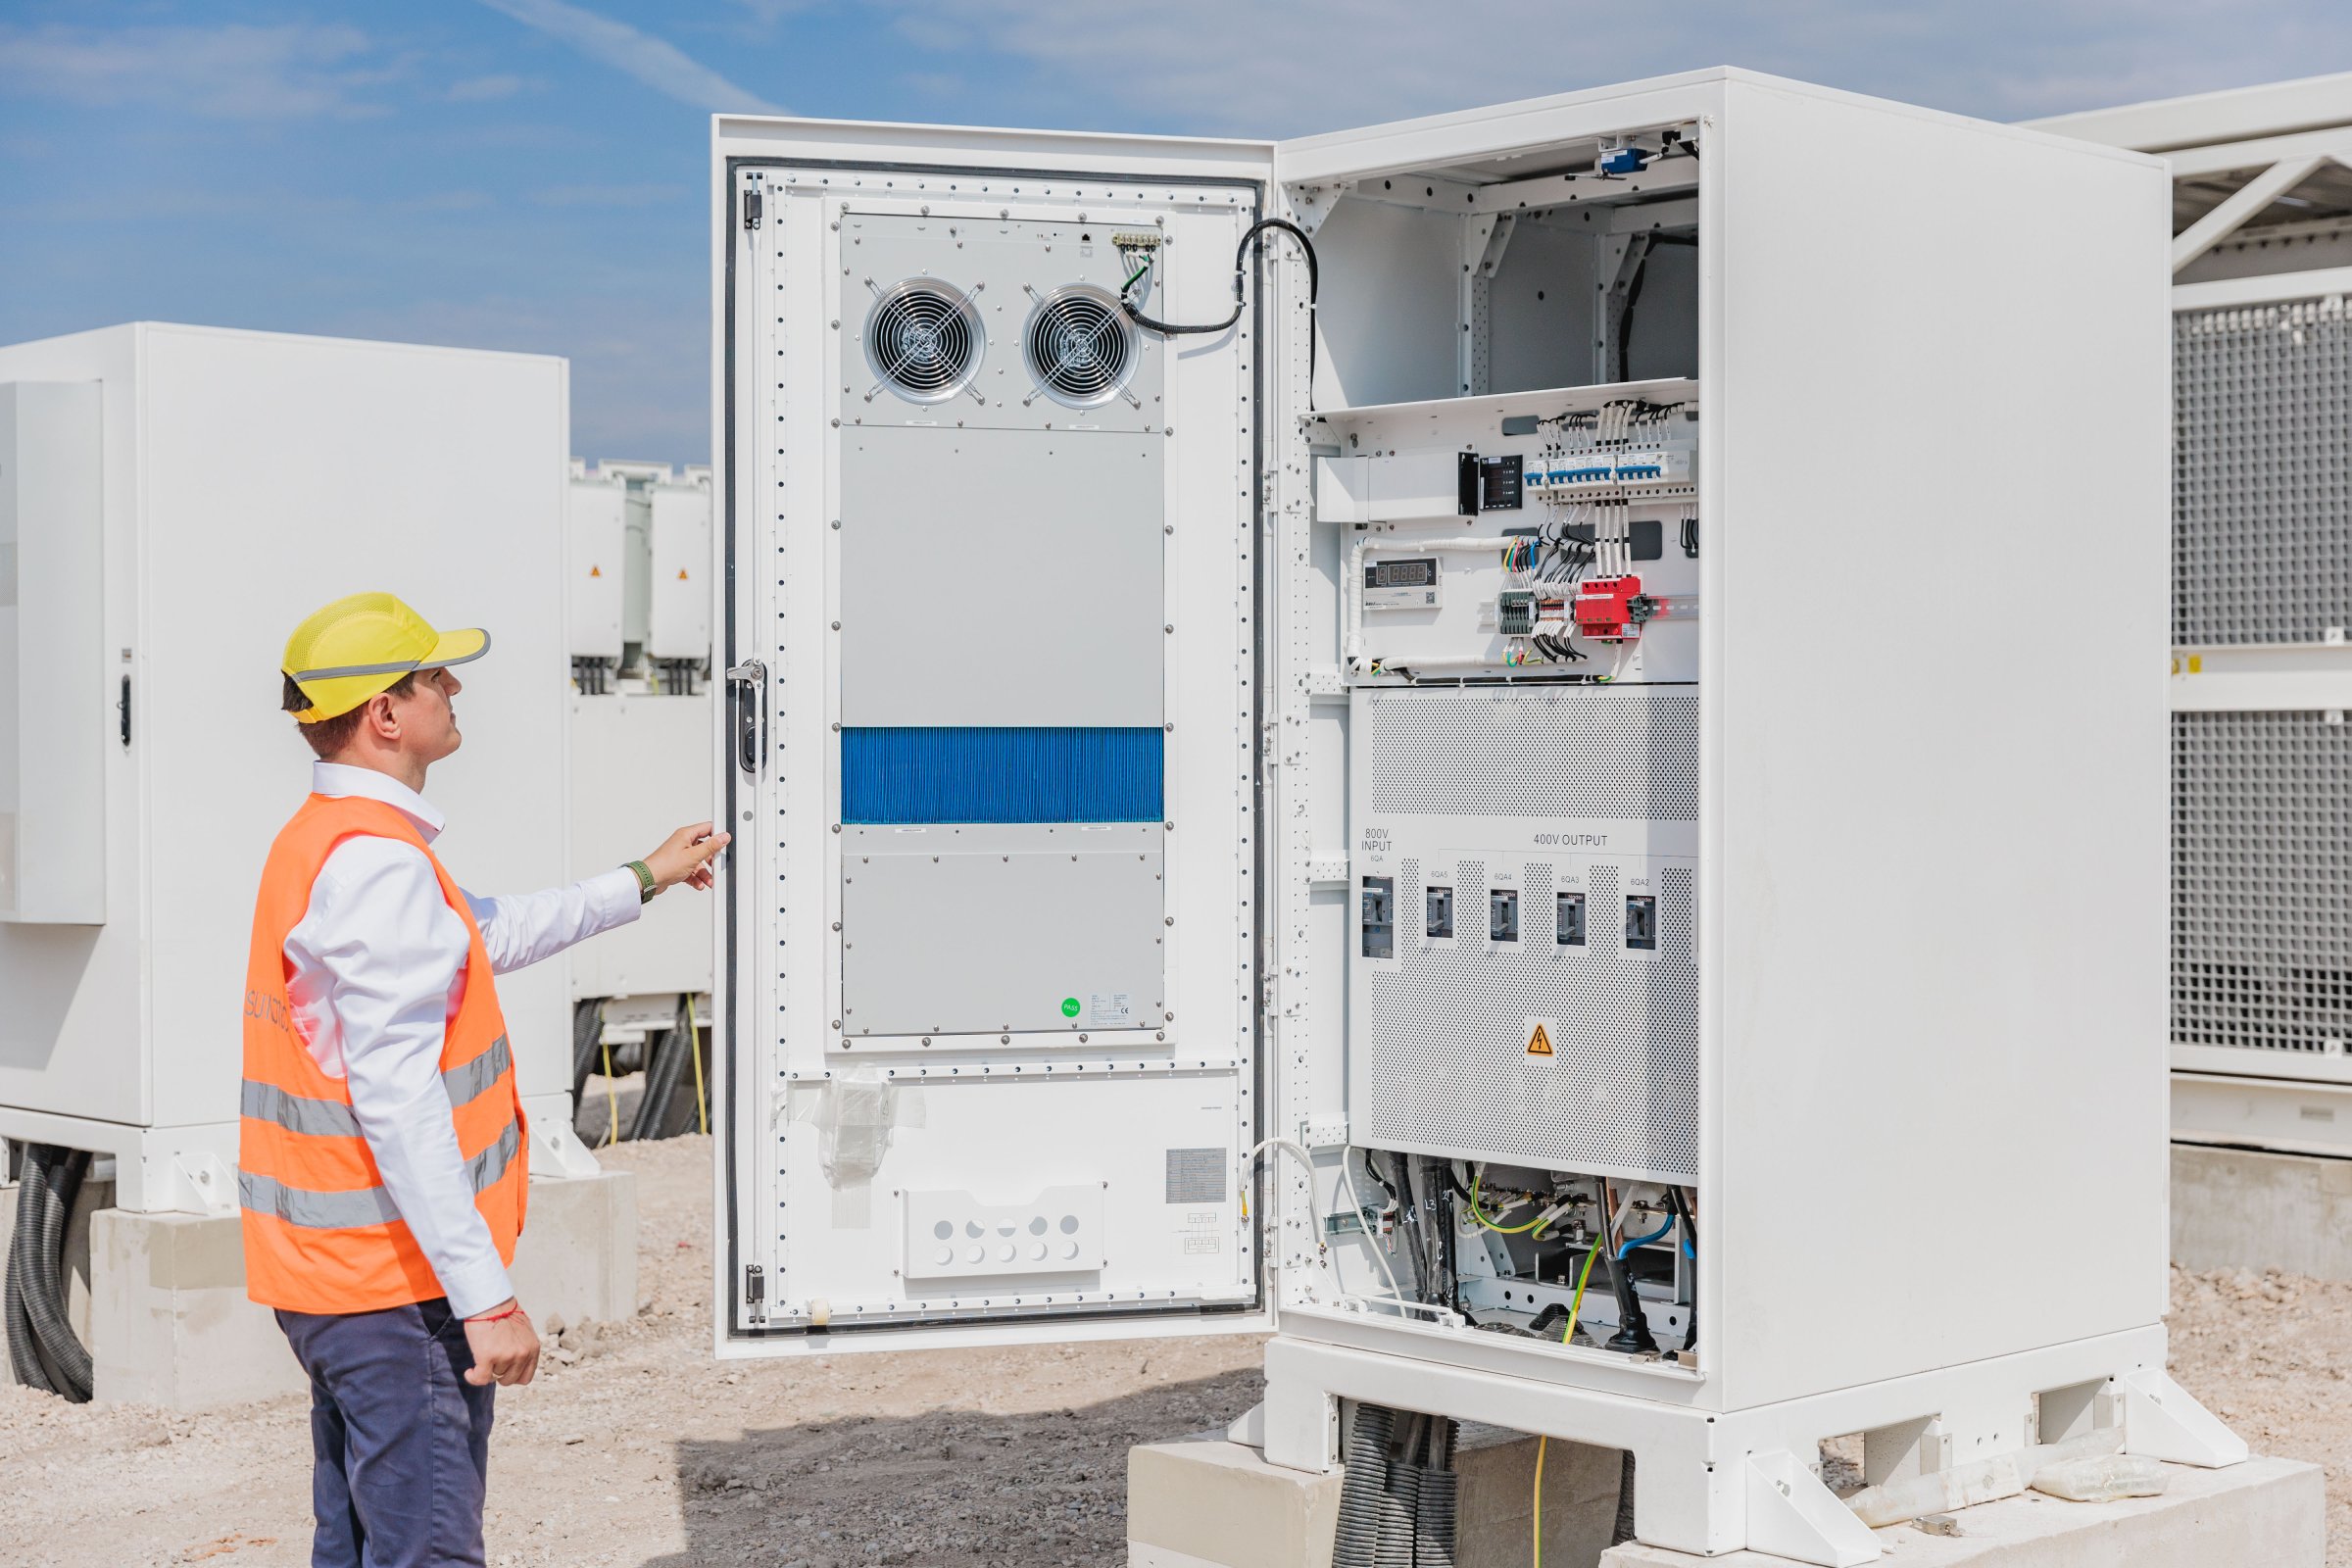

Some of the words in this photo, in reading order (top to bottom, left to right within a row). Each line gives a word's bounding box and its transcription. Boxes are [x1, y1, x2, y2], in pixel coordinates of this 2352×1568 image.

[1365, 828, 1390, 839] 800V
[1534, 833, 1559, 845] 400V
[1561, 834, 1608, 847] OUTPUT
[1361, 840, 1393, 852] INPUT
[1560, 875, 1580, 884] 6QA3
[1630, 878, 1649, 887] 6QA2
[1424, 1199, 1437, 1211] L3
